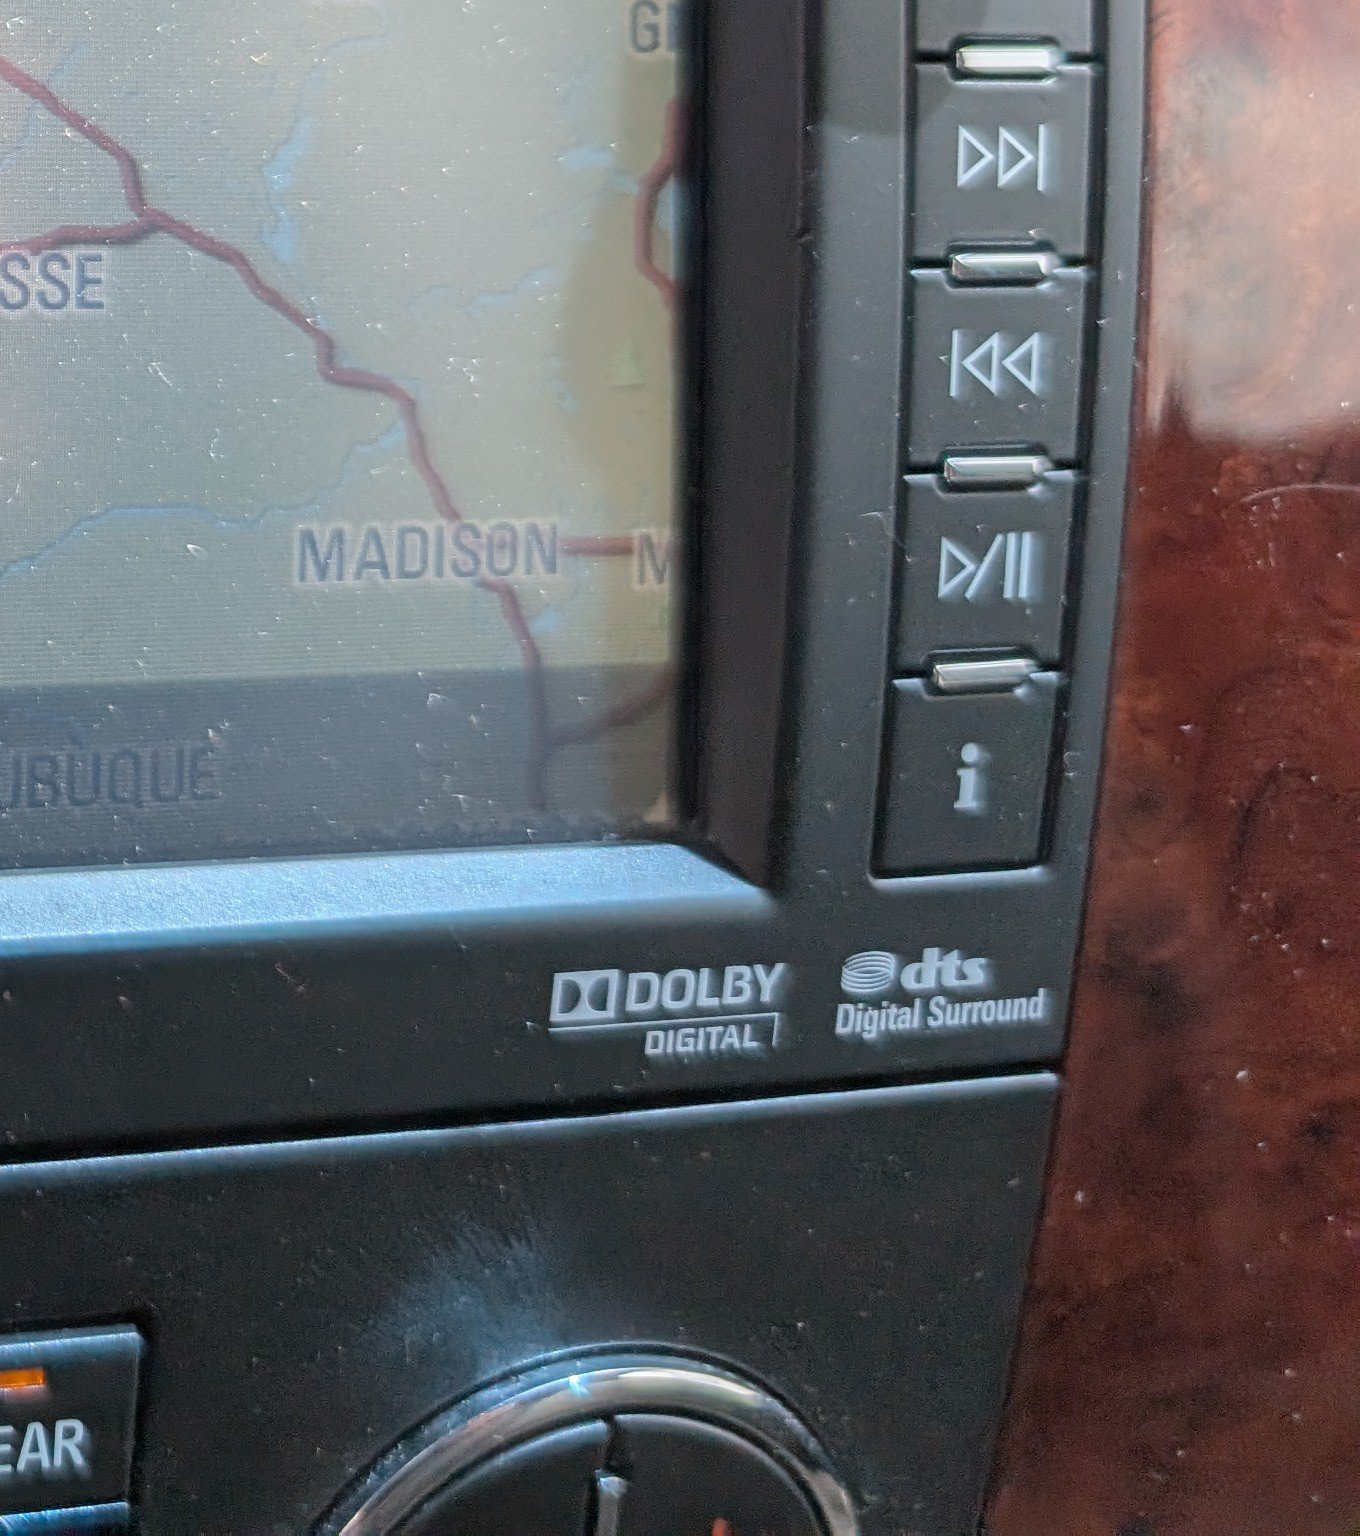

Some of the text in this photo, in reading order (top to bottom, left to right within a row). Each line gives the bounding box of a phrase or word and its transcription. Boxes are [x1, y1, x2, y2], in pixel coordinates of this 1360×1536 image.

[297, 524, 559, 583] MADISON
[626, 963, 784, 1014] DOLBY
[901, 947, 988, 992] dts
[644, 1024, 759, 1057] DIGITAL
[835, 989, 1046, 1041] Digital Surround
